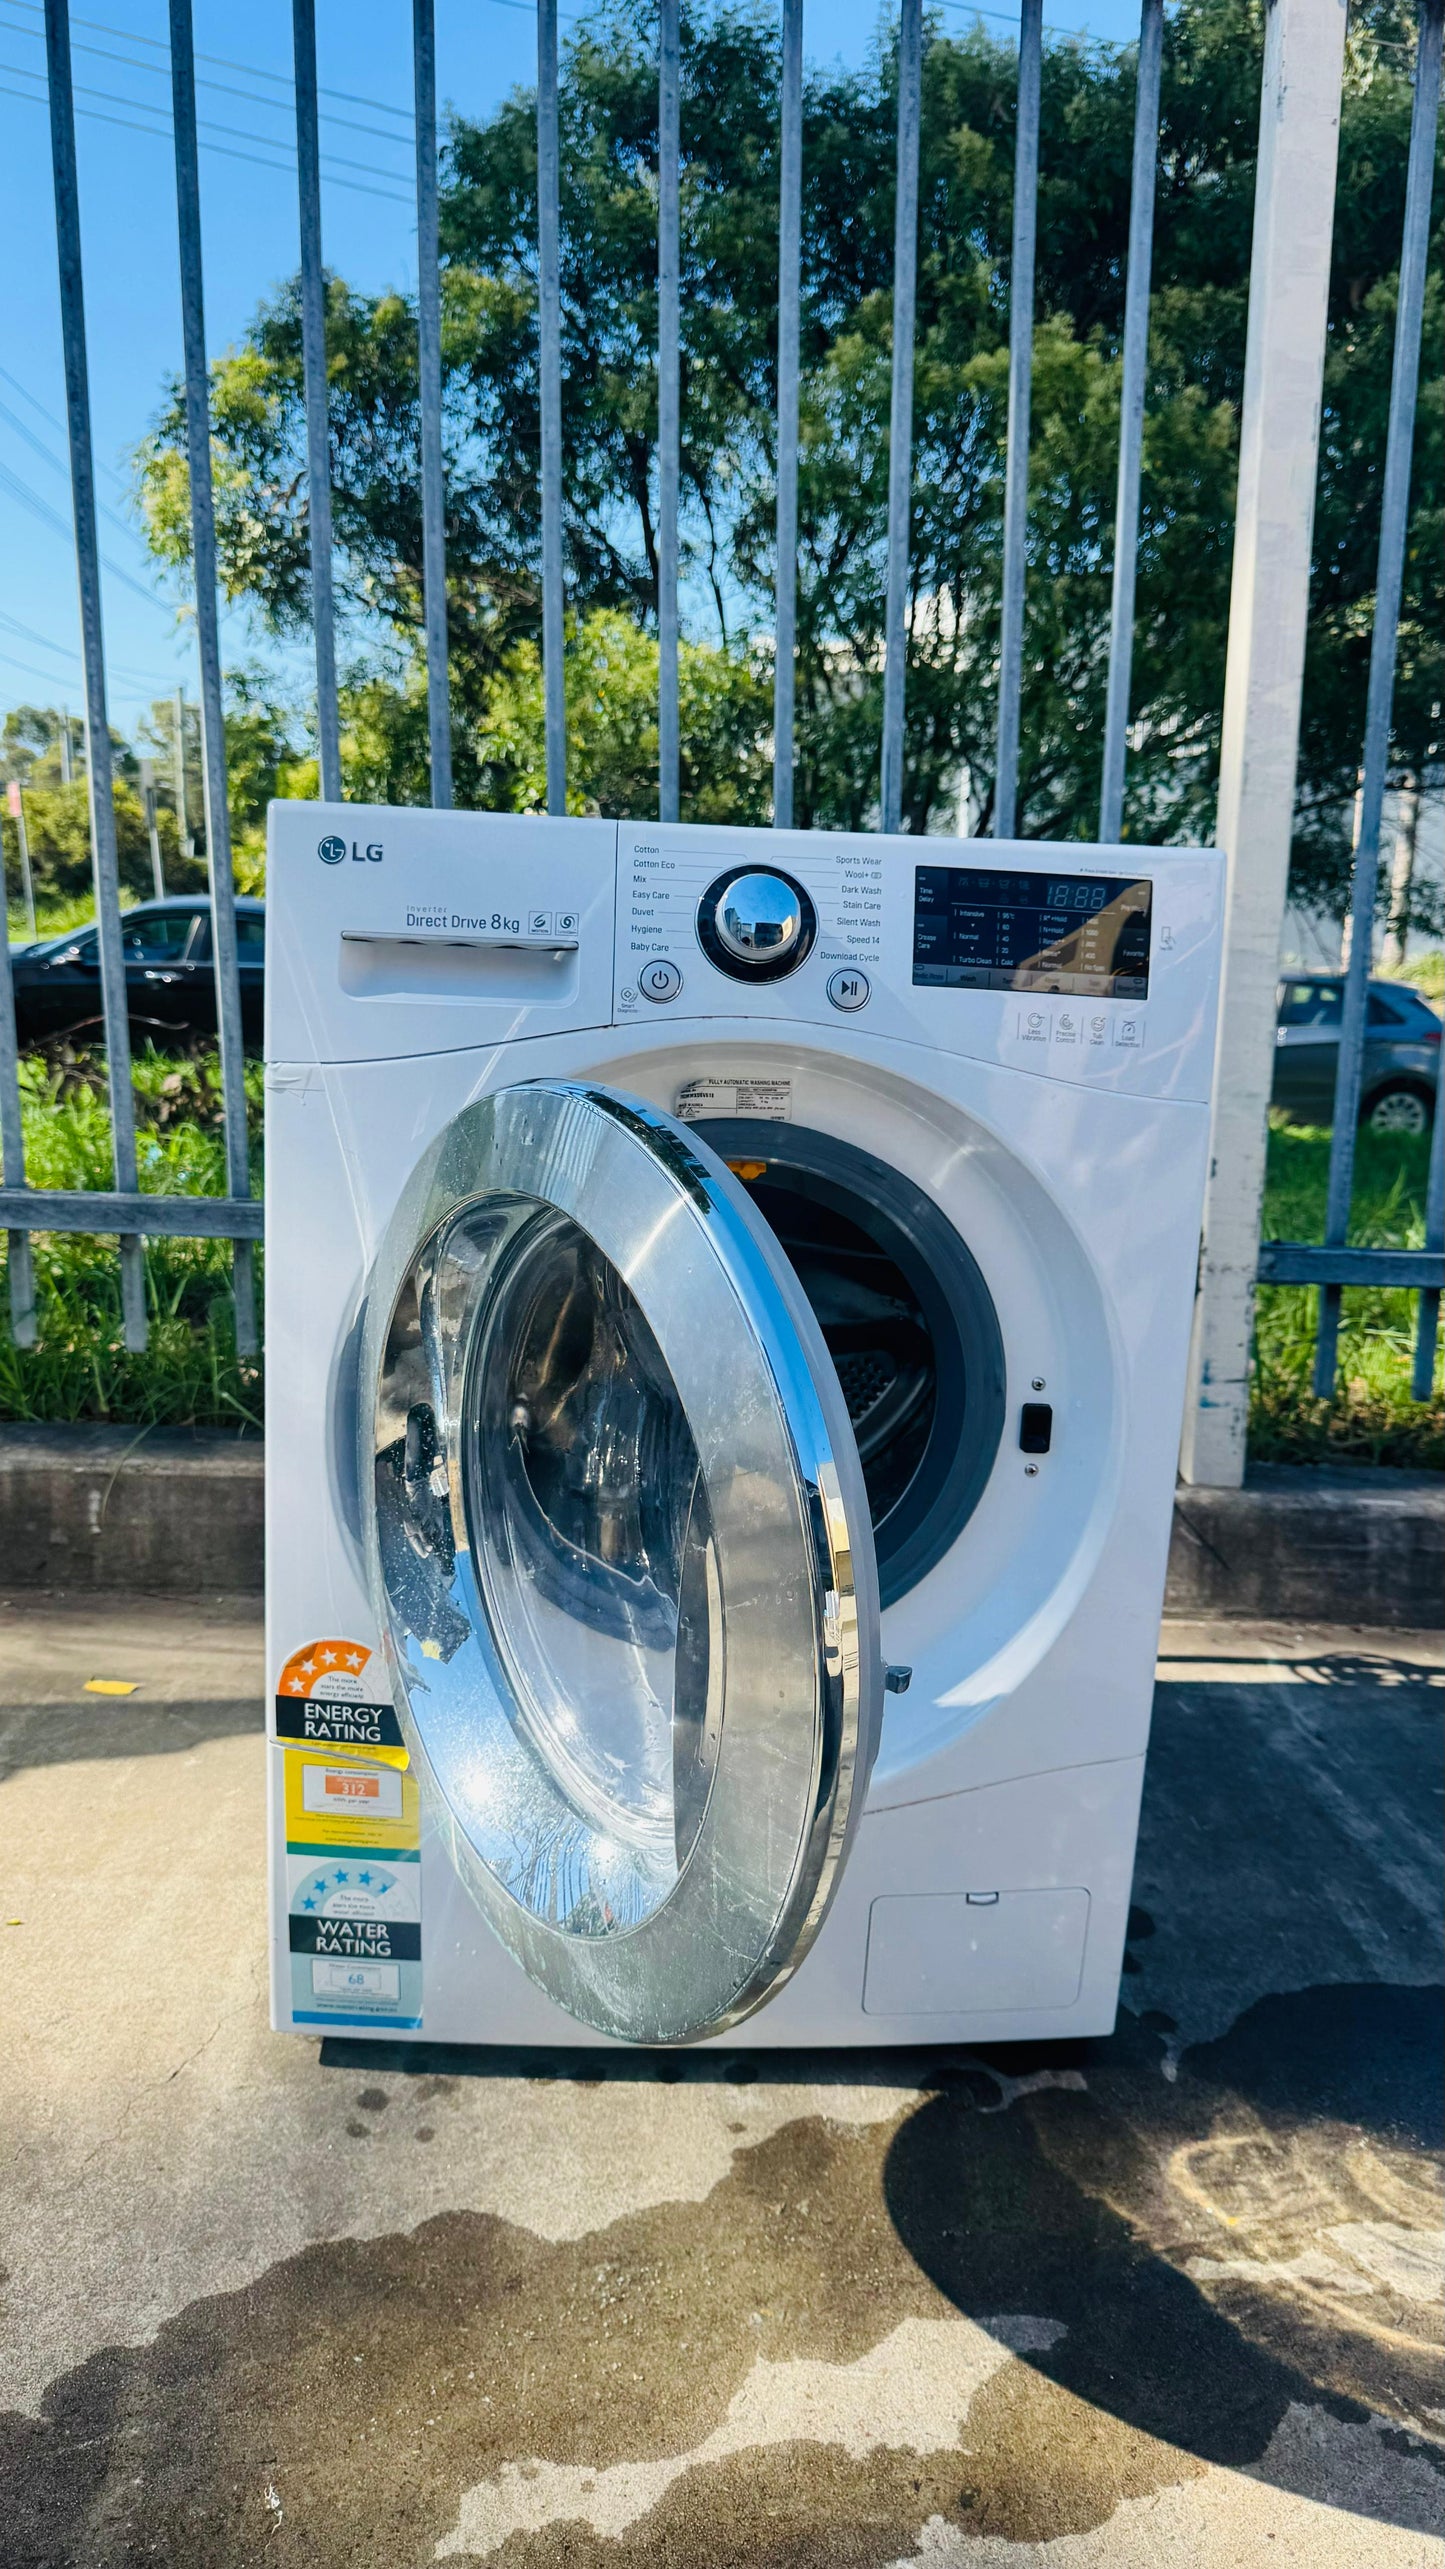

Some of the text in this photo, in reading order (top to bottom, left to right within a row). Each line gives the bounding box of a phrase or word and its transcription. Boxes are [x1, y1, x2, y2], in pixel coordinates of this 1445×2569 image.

[352, 841, 384, 862] LG
[634, 845, 660, 854] Cotton
[634, 860, 676, 870] Cotton Eco
[836, 856, 882, 866] Sports Wear
[633, 875, 647, 884] Mix
[845, 870, 868, 880] Wool+
[632, 891, 670, 901] Easy Care
[842, 886, 882, 896] Dark Wash
[406, 905, 448, 913] Inverter
[843, 900, 882, 910] Stain Care
[632, 907, 654, 916] Duvet
[406, 914, 448, 928] Direct
[451, 915, 487, 929] Drive
[837, 918, 881, 928] Silent Wash
[631, 925, 662, 936] Hygiene
[847, 936, 880, 946] Speed 14
[631, 942, 670, 952] Baby Care
[820, 952, 880, 962] Download Cycle
[304, 1703, 382, 1724] ENERGY
[304, 1721, 381, 1742] RATING
[342, 1783, 366, 1796] 312
[317, 1920, 389, 1939] WATER
[316, 1937, 392, 1956] RATING
[348, 1974, 365, 1985] 68
